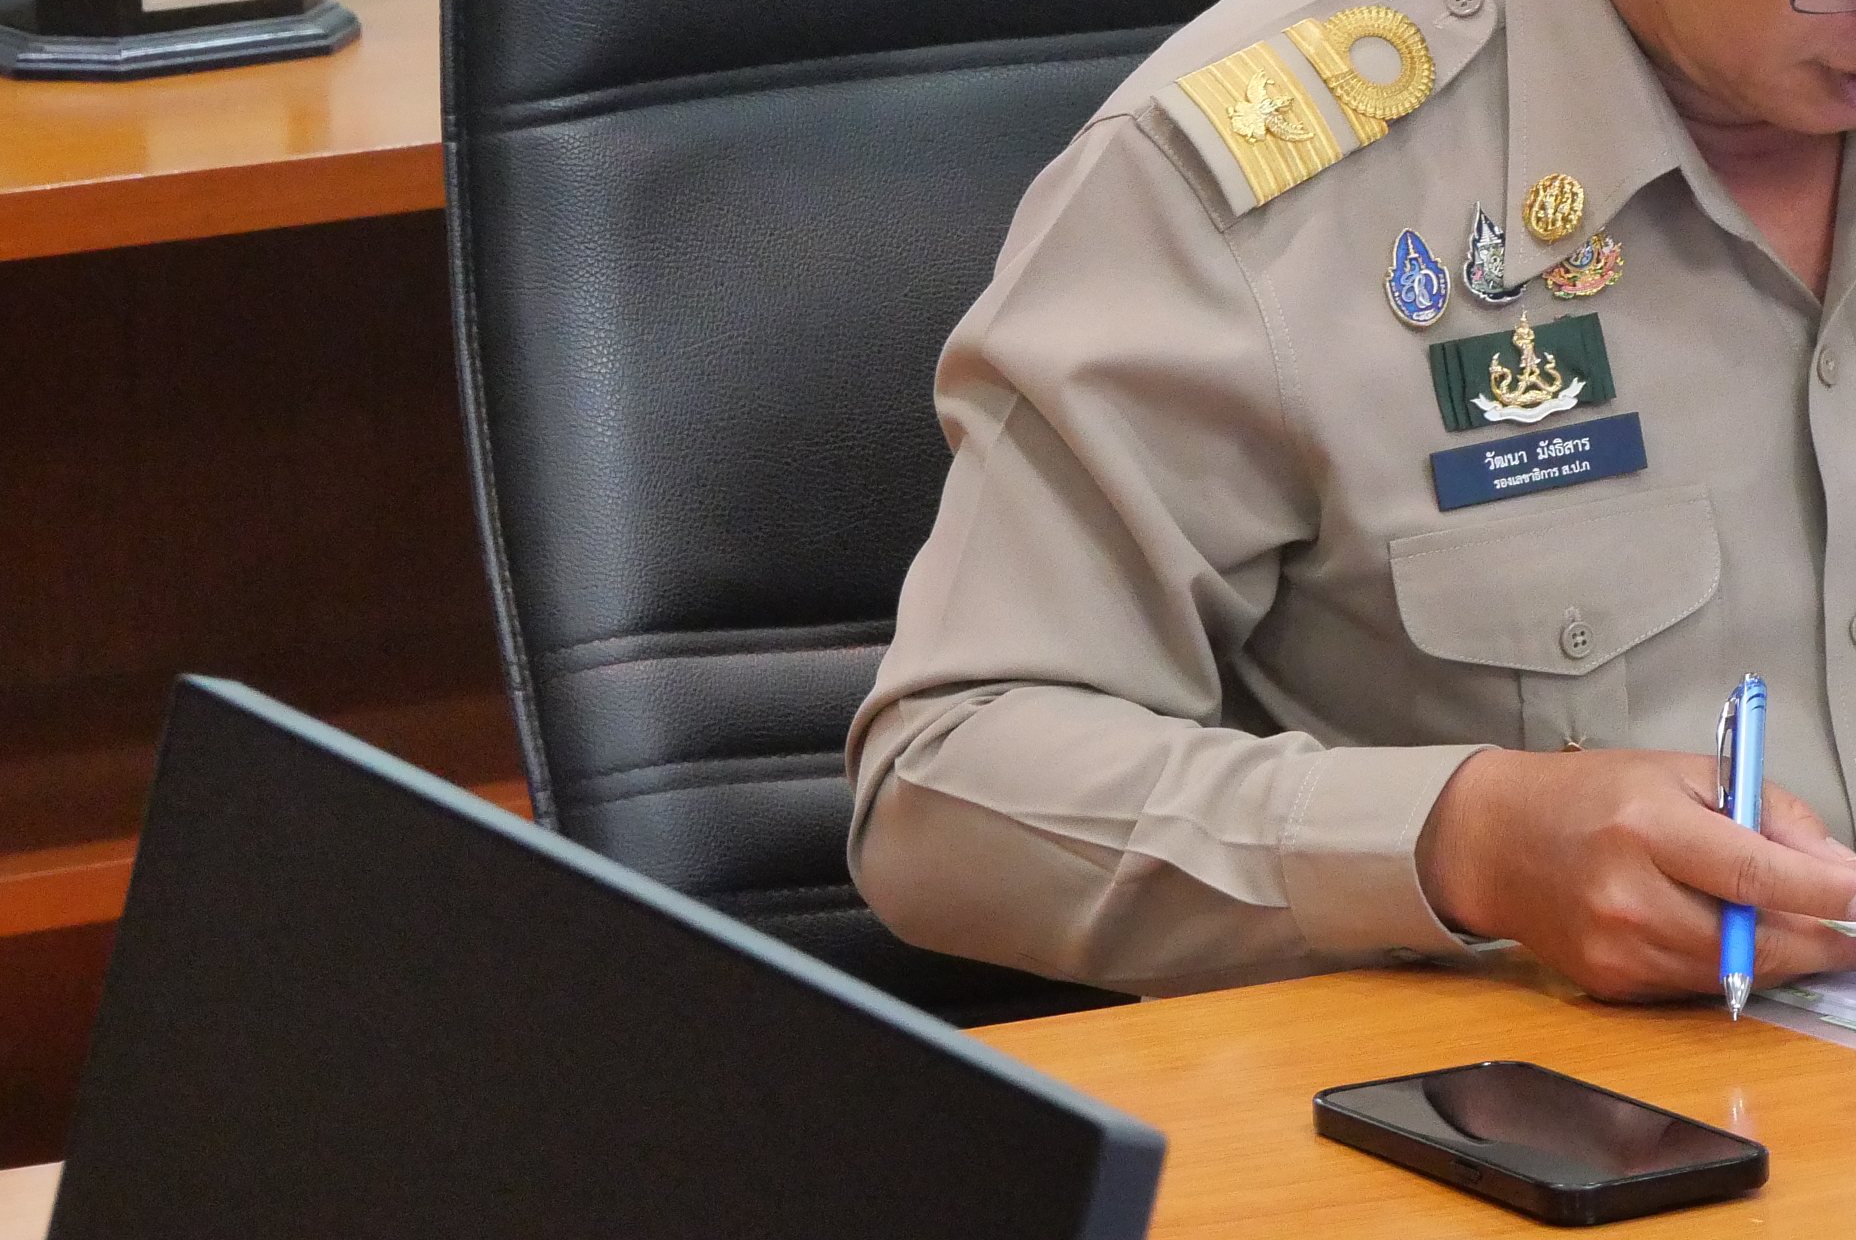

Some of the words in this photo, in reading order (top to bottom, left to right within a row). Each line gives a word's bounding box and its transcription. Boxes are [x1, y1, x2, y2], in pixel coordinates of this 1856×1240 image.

[1485, 450, 1527, 470] วัฒนา
[1536, 437, 1590, 460] มังธิสาร
[1493, 467, 1559, 489] รองเลขาธิการ
